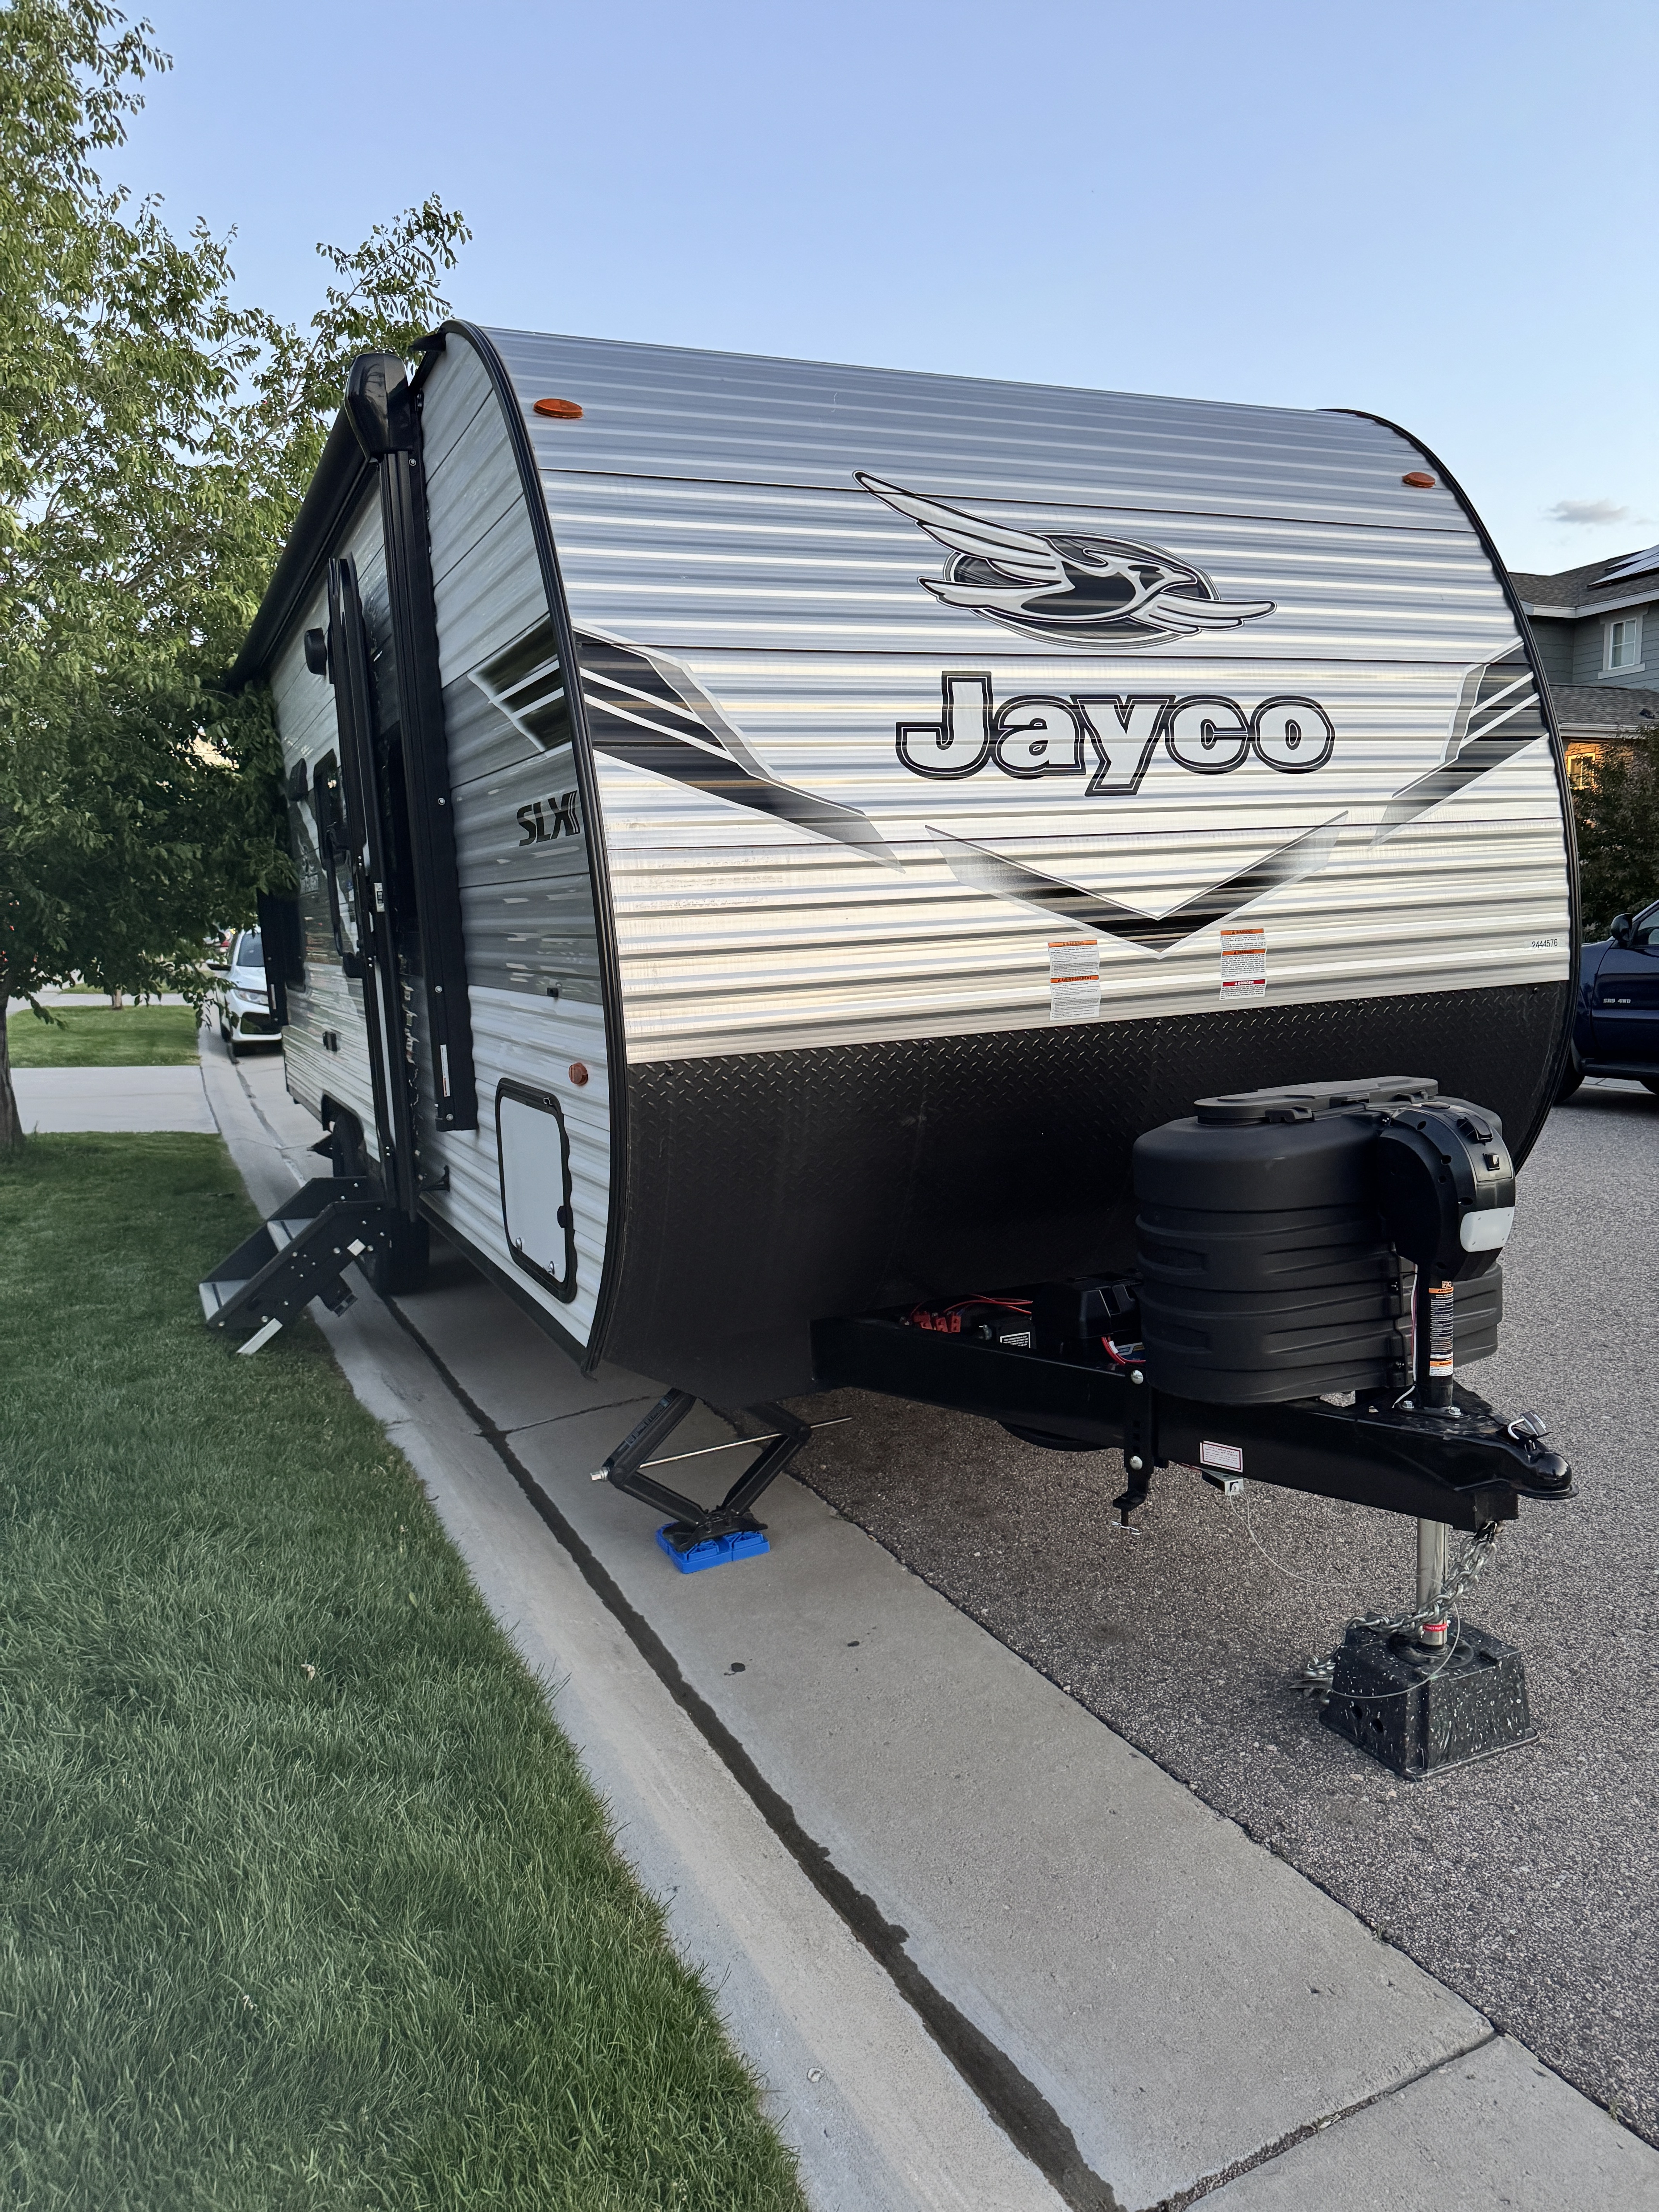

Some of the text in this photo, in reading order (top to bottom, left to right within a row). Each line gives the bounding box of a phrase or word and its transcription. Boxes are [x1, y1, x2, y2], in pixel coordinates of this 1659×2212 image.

[896, 670, 1335, 796] Jayco
[516, 790, 580, 847] SLX
[1532, 939, 1558, 948] 2444576
